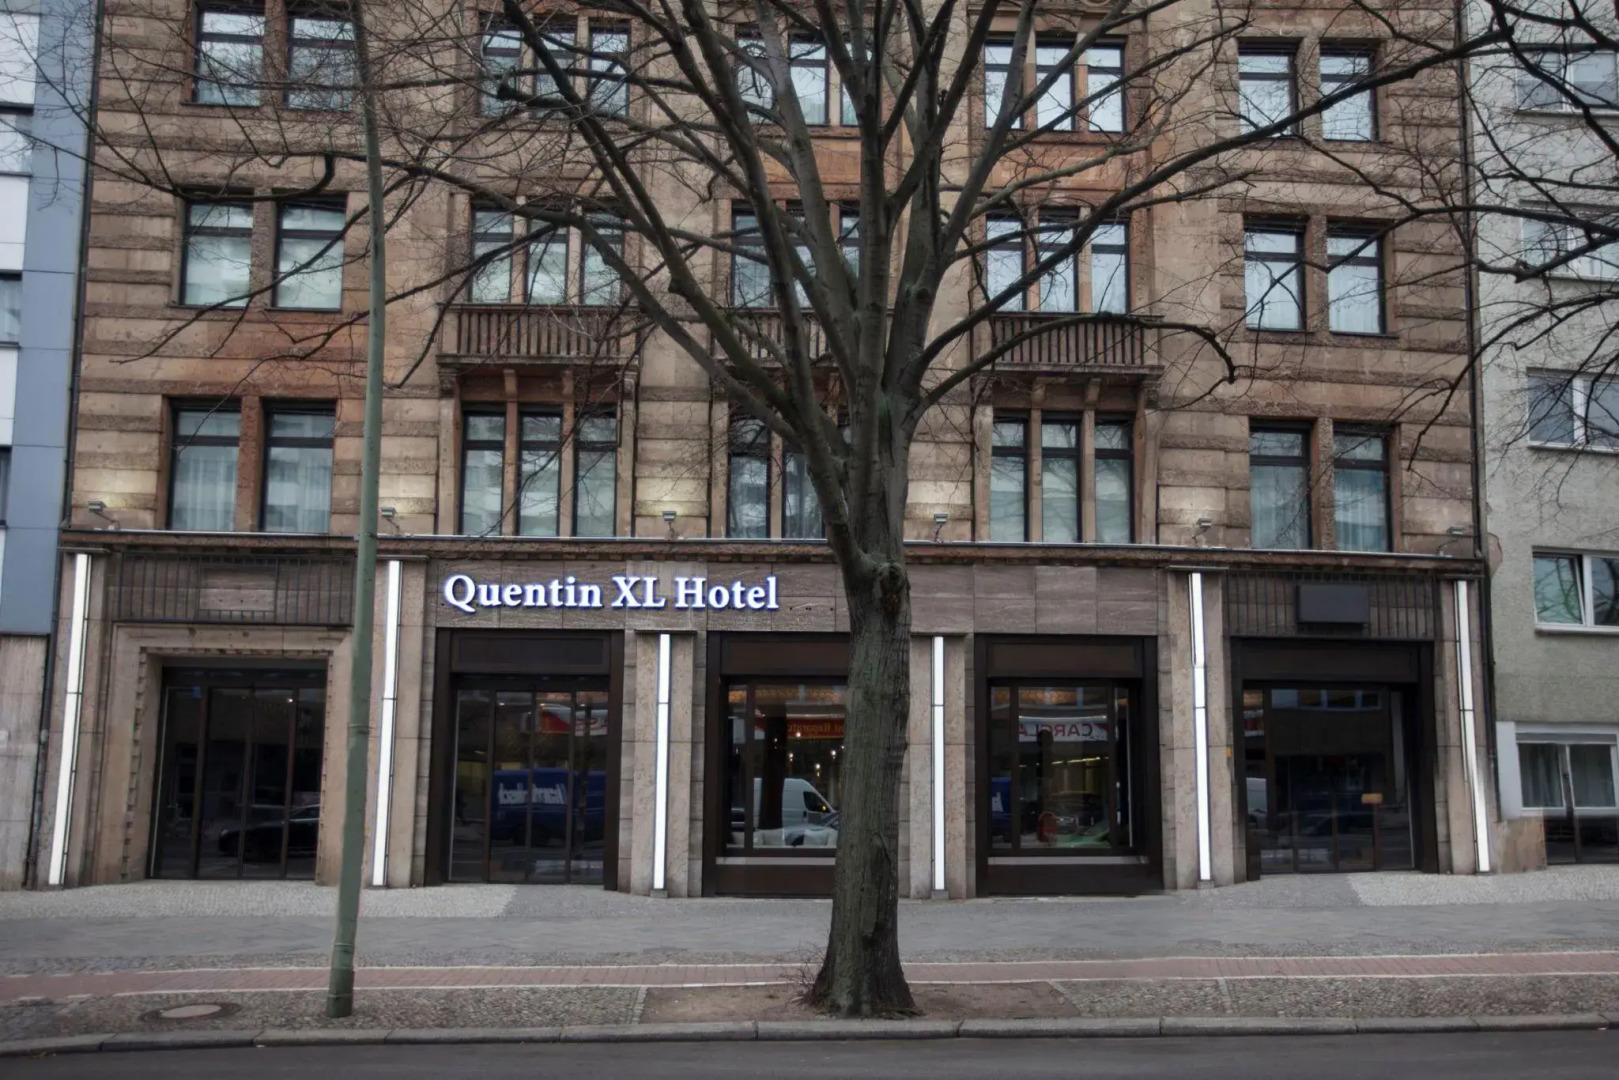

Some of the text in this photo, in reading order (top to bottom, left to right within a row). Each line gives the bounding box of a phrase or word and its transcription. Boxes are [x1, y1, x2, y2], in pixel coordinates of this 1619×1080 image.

[444, 574, 779, 613] Quentin XL Hotel
